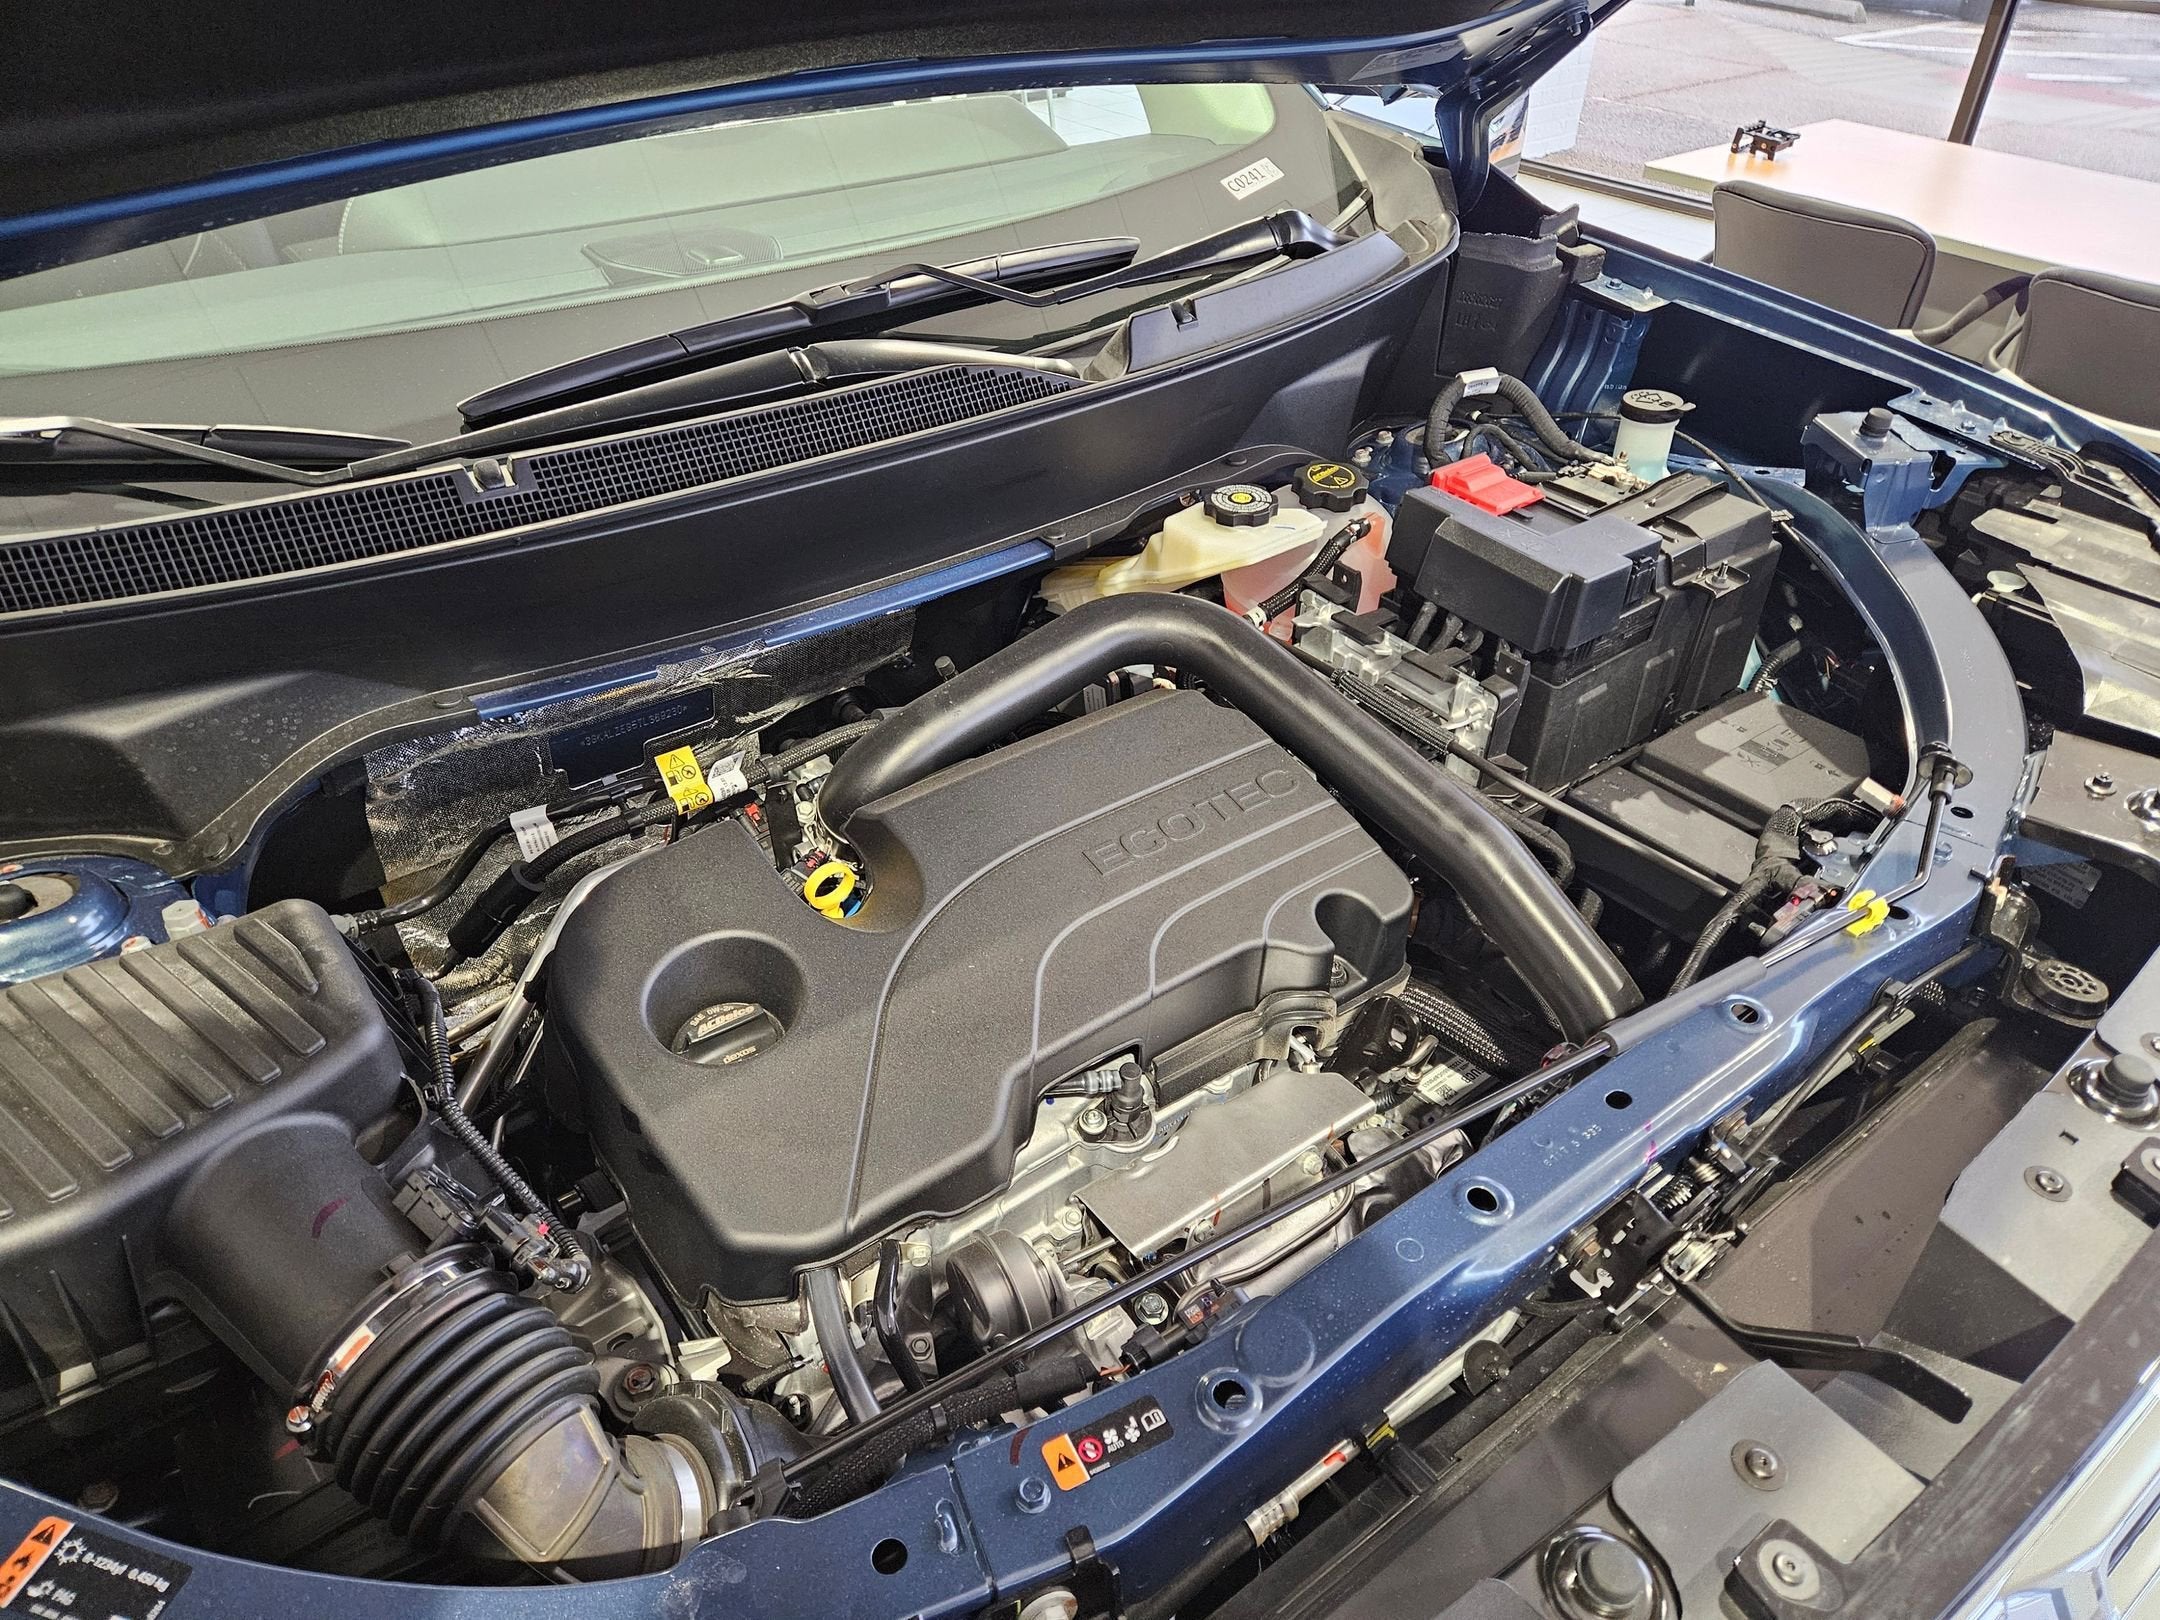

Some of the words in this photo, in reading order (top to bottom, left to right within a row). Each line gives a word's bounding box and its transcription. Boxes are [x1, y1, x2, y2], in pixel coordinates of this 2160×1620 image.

[1227, 167, 1266, 192] C0241
[1081, 769, 1299, 876] ECOTEC
[689, 1013, 706, 1027] SAE
[697, 1005, 755, 1038] ACDelco
[723, 1045, 757, 1064] dexos
[1107, 1439, 1125, 1454] AUTO
